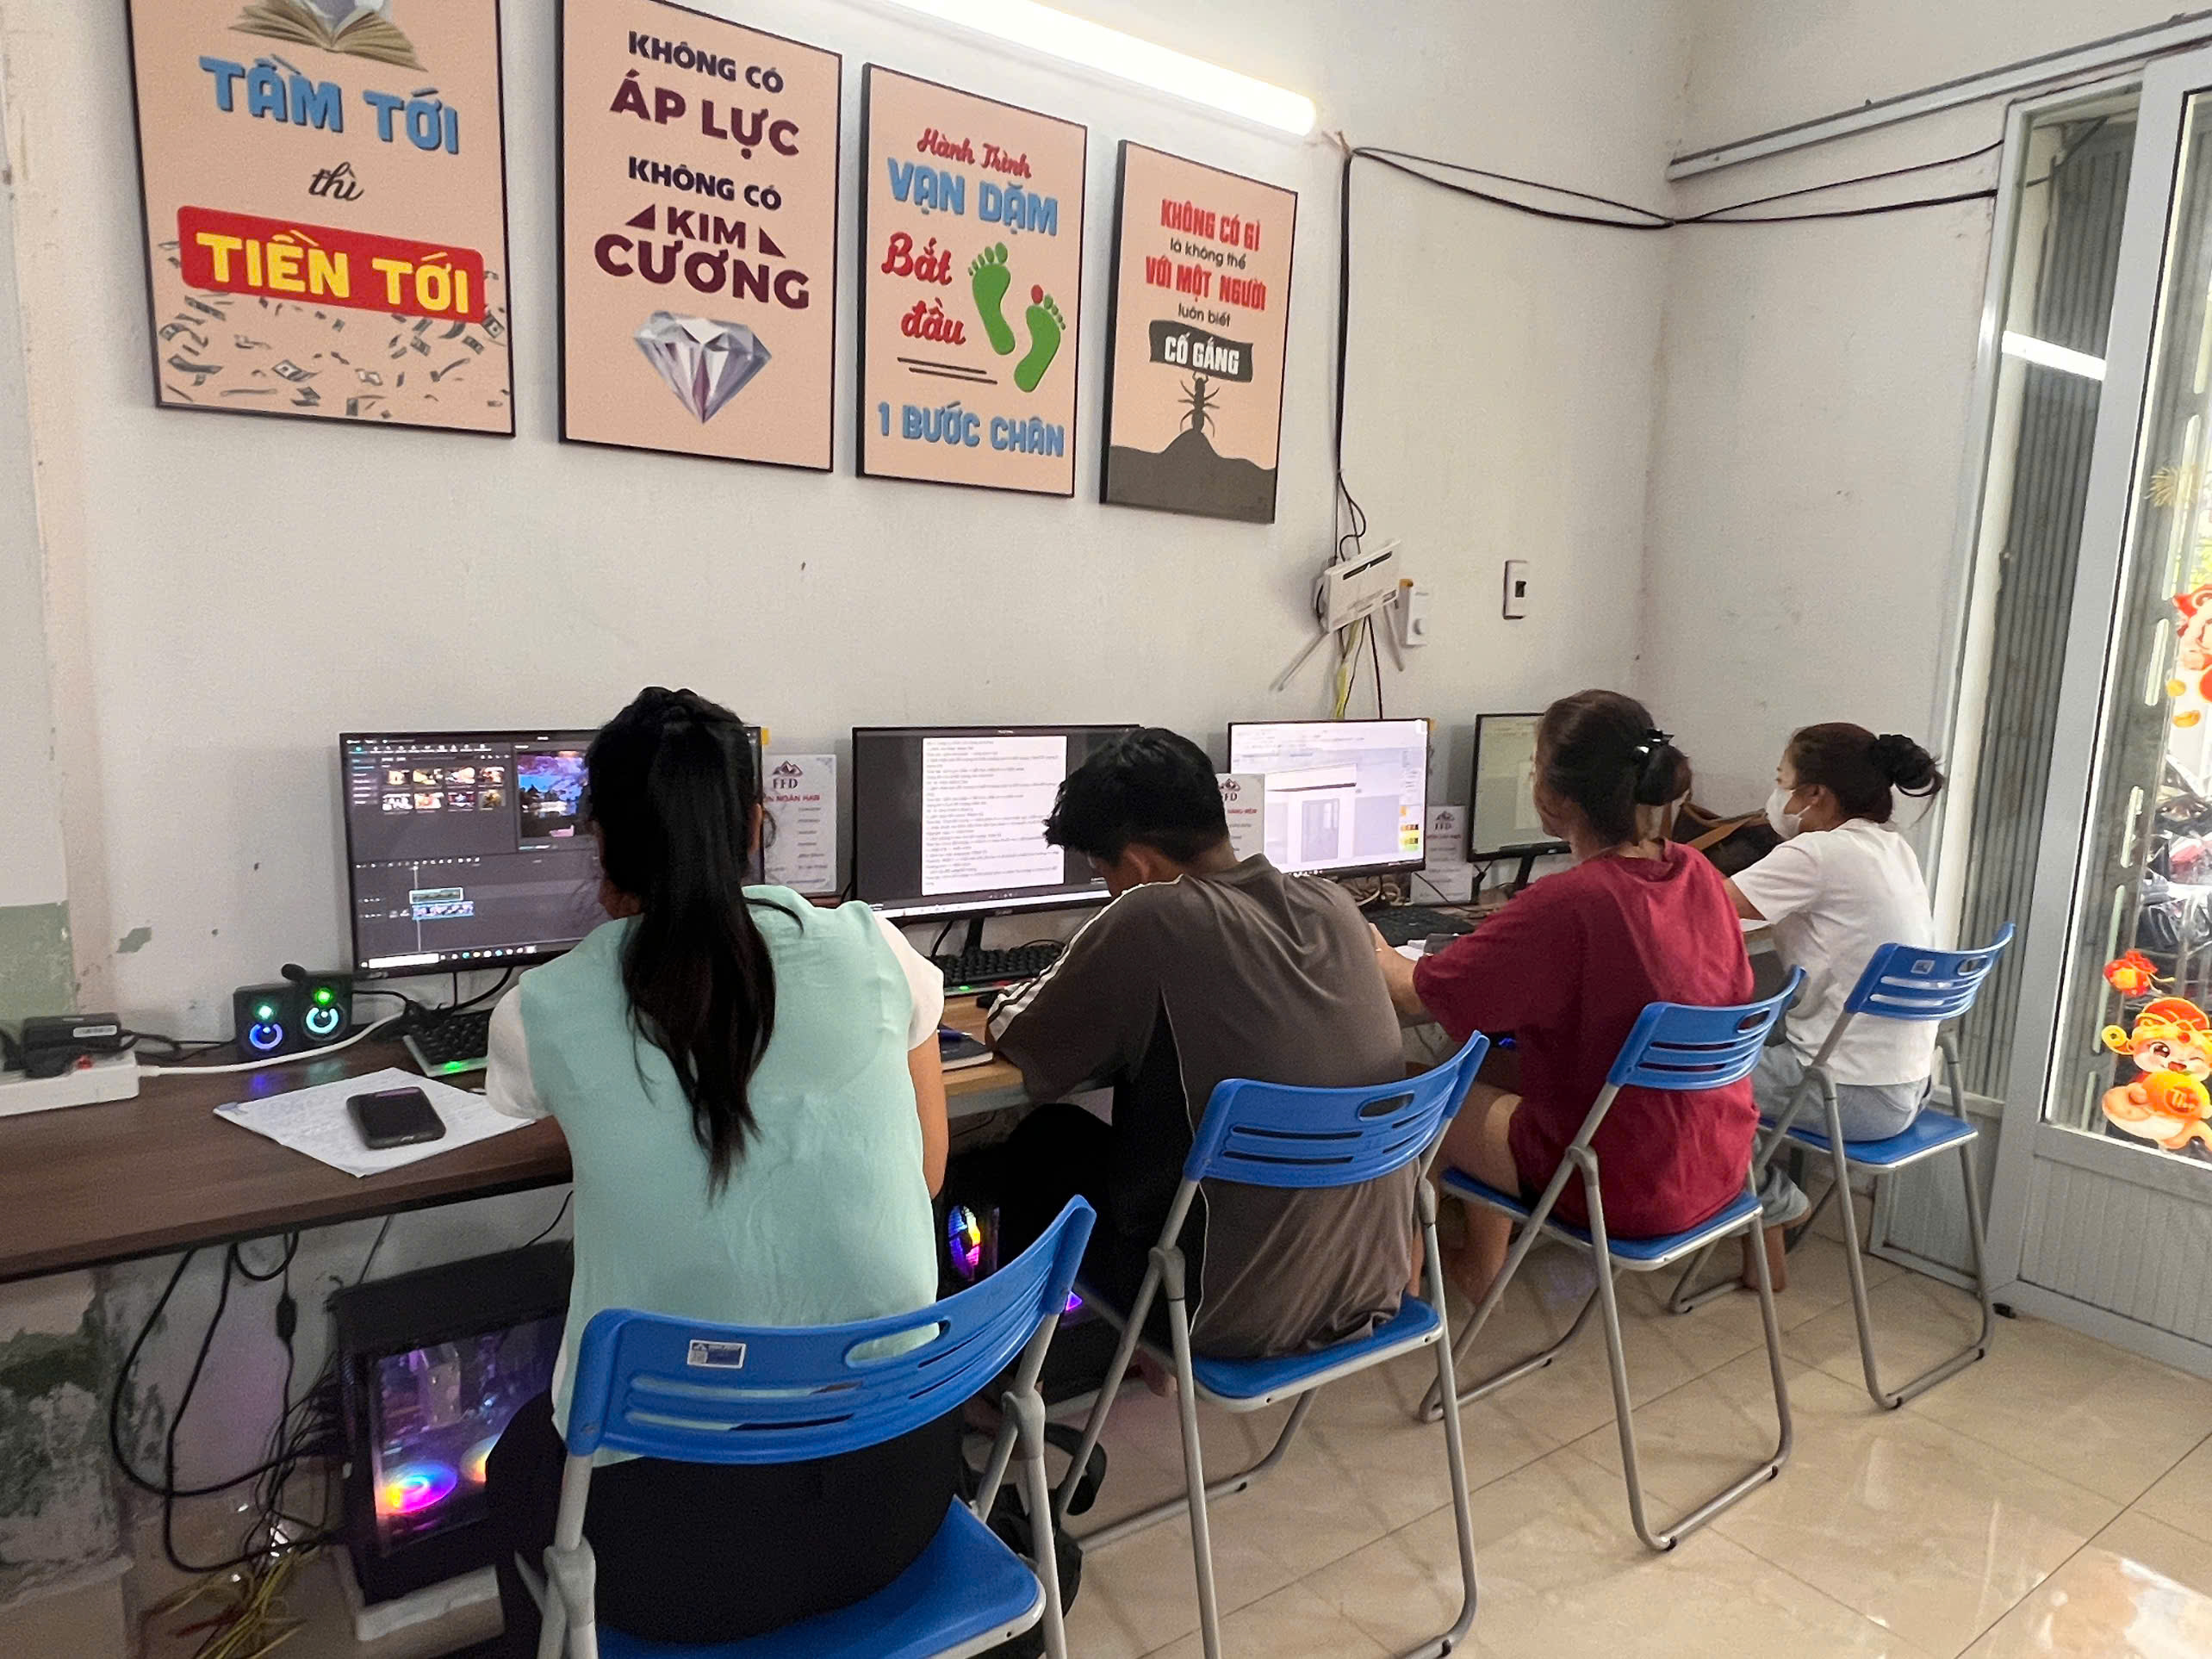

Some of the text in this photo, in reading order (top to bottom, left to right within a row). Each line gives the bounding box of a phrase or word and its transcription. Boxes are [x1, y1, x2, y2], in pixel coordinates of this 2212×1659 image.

[629, 31, 784, 93] KHÔNG CÓ
[199, 54, 459, 154] TẦM TỚI
[610, 68, 799, 159] ÁP LỰC
[917, 127, 975, 165] Hành
[308, 162, 363, 202] thì
[629, 156, 782, 210] KHÔNG CÓ
[887, 157, 1058, 236] VẠN DẶM
[668, 206, 746, 250] KIM
[1161, 199, 1215, 239] KHÔNG
[1220, 214, 1240, 245] CÓ
[196, 229, 469, 314] TIỀN TỚI
[594, 233, 809, 309] CƯƠNG
[881, 232, 952, 285] Bắt
[1185, 241, 1224, 267] không
[1146, 255, 1267, 310] VỚI MỘT NGƯỜI
[901, 297, 966, 345] đầu
[1178, 303, 1204, 321] luôn
[1165, 332, 1240, 375] CỐ GẮNG
[878, 401, 1065, 457] 1 BƯỚC CHÂN
